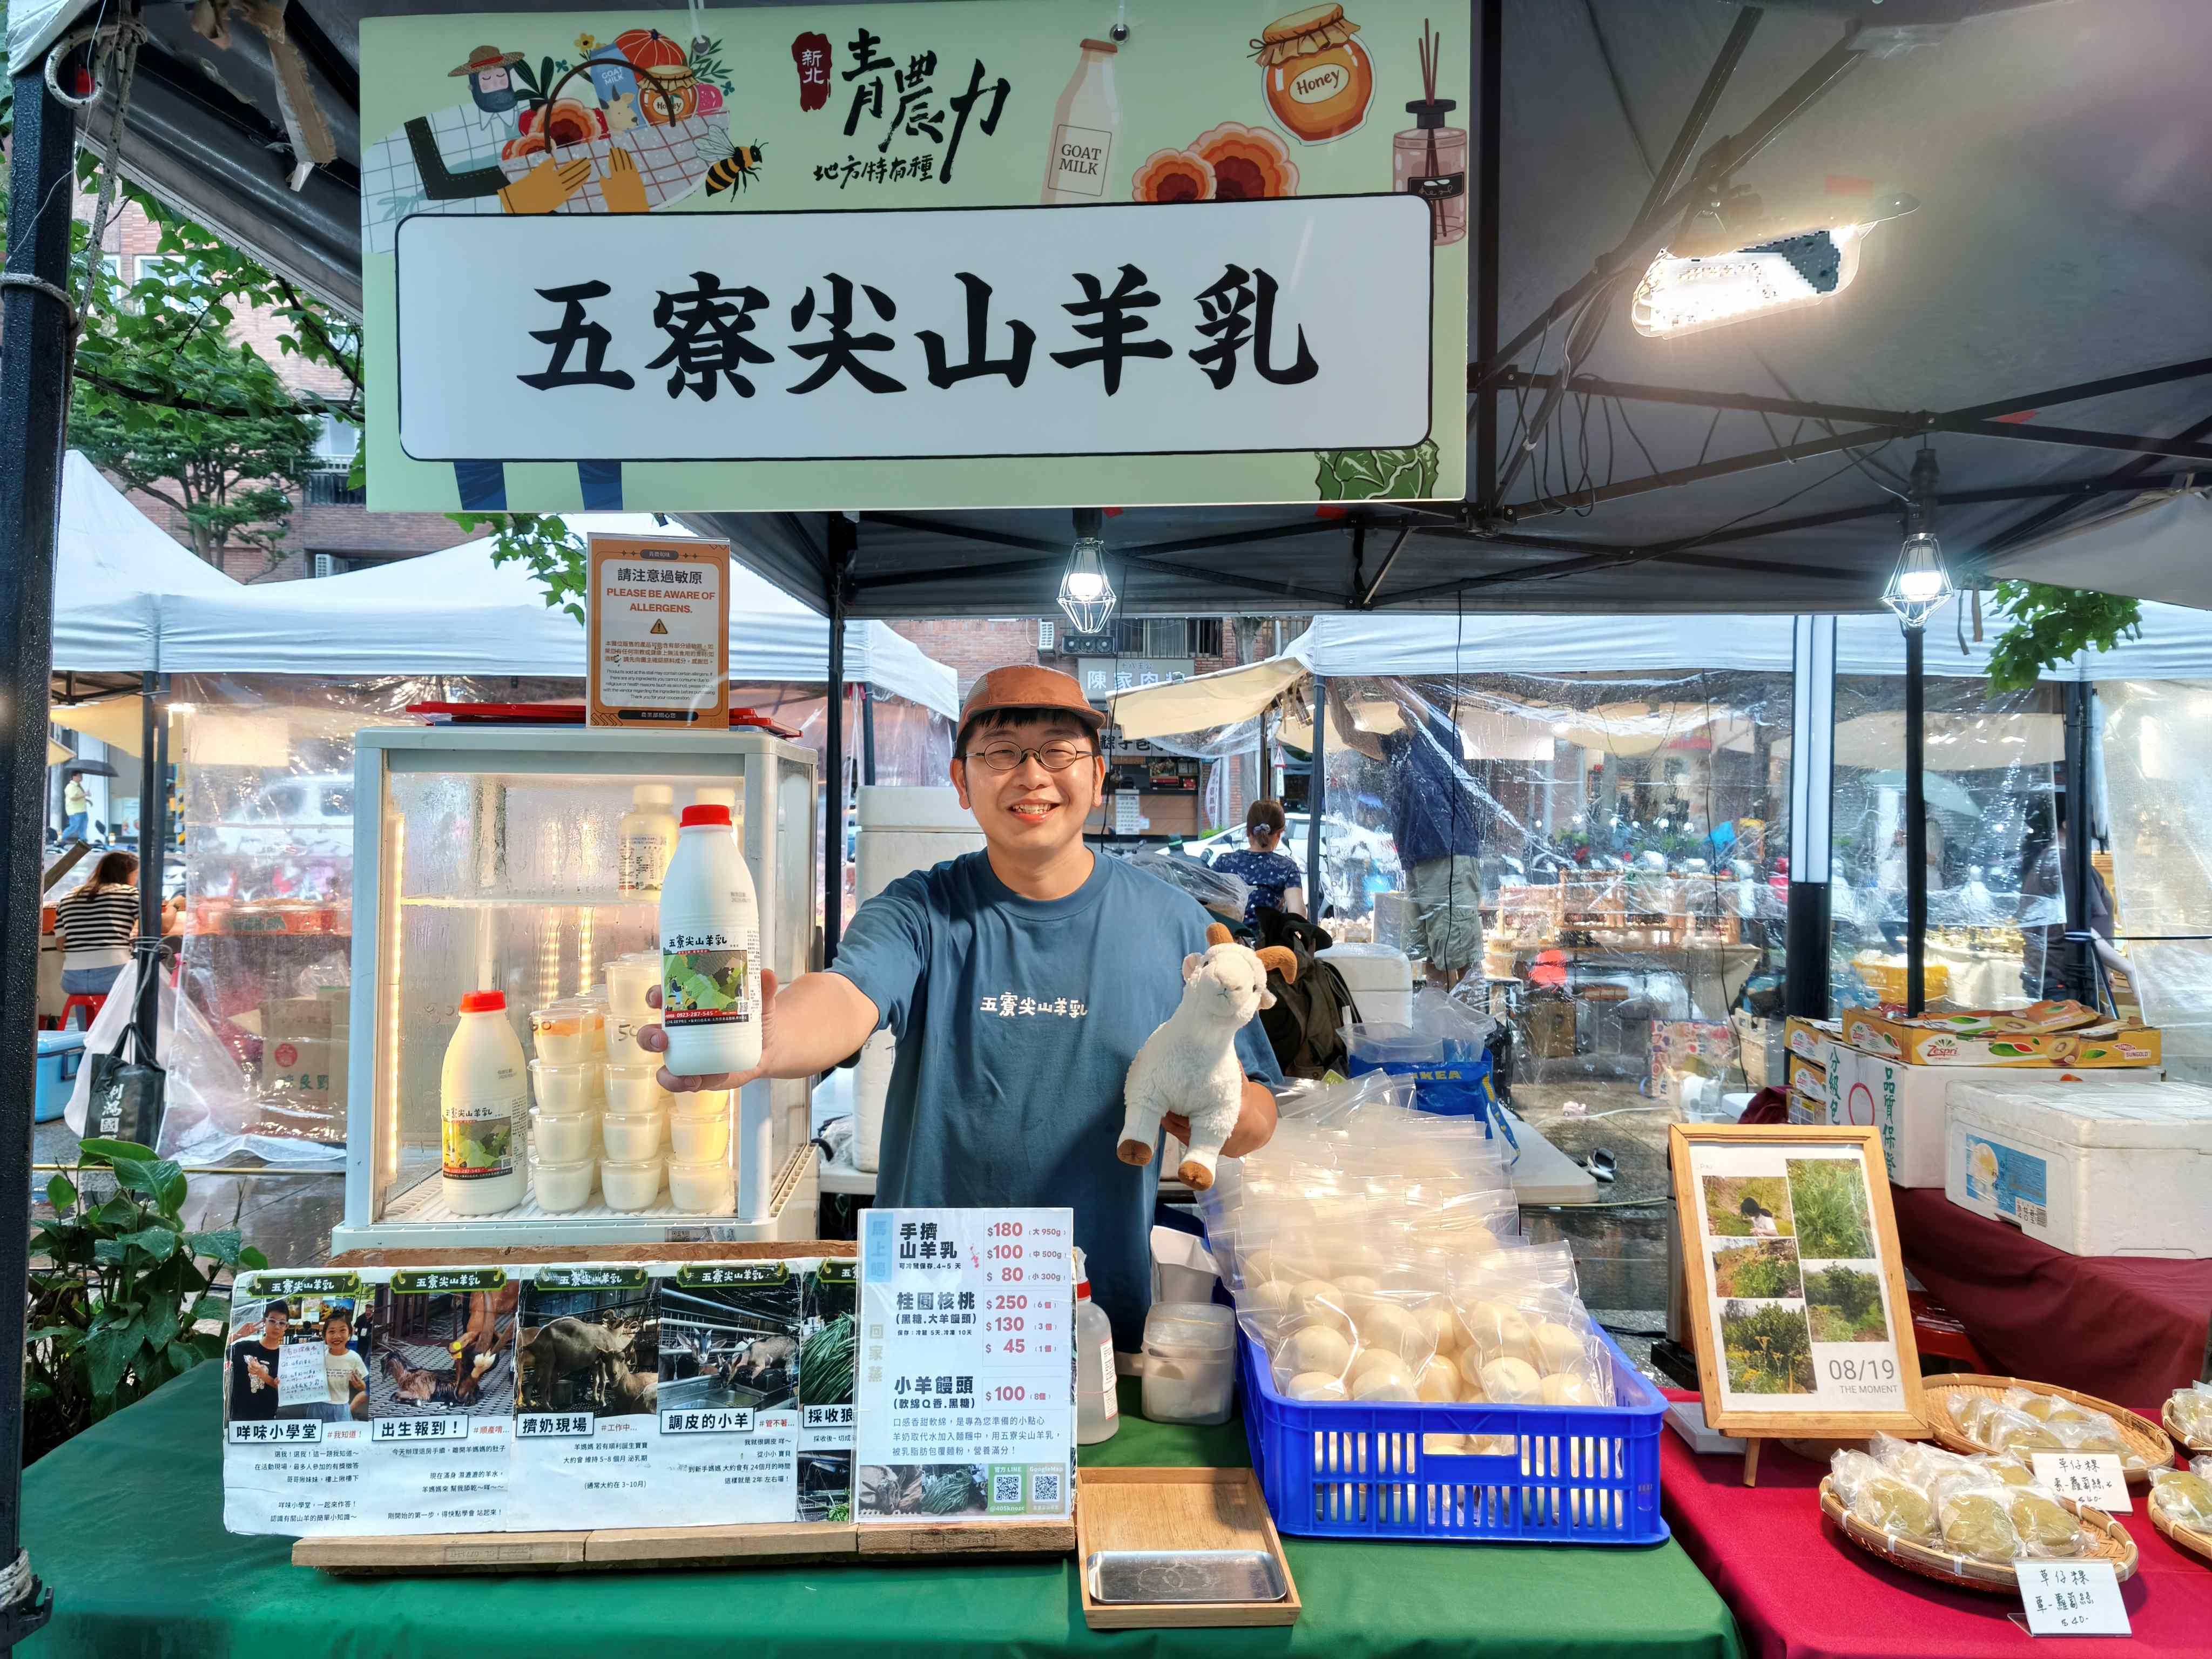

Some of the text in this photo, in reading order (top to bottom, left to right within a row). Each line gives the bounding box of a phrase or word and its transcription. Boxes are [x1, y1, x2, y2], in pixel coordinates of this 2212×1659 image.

[602, 66, 622, 79] GOAT
[802, 49, 825, 84] 新北
[604, 75, 624, 86] MILK
[1296, 69, 1341, 96] Honey
[657, 101, 682, 112] Hoey
[841, 28, 1011, 184] 青農力
[1061, 144, 1102, 162] GOAT
[813, 154, 934, 190] 地方特有種
[1059, 159, 1098, 176] MILK
[516, 263, 1319, 402] 五寮尖山羊乳
[618, 568, 703, 584] 請注意過敏原
[606, 588, 716, 601] PLEASE BE AWARE OF
[630, 603, 693, 613] ALLERGENS.
[669, 934, 727, 949] 五寮尖山羊乳
[980, 992, 1088, 1019] 五寮尖山羊乳
[1927, 1044, 1960, 1057] Zespri
[900, 1222, 938, 1241] 手擠
[987, 1222, 1023, 1237] $180
[900, 1241, 957, 1259] 山羊乳
[987, 1244, 1023, 1259] $100
[416, 1274, 481, 1290] 五寮尖山羊乳
[702, 1269, 764, 1284] 五寮尖山羊乳
[271, 1278, 334, 1294] 五寮尖山羊乳
[896, 1291, 975, 1311] 桂圓核桃
[1829, 1359, 1894, 1381] 08/19
[894, 1375, 974, 1395] 小羊饅頭
[1839, 1385, 1897, 1394] THE MOMENT
[381, 1420, 458, 1438] 出生報到！
[523, 1417, 587, 1434] 擠奶現場
[669, 1413, 748, 1430] 調皮的小羊
[596, 1442, 648, 1451] 若有順利誕生寶寶
[563, 1456, 583, 1464] 大約會
[689, 1465, 721, 1473] 到新手媽媽
[725, 1476, 751, 1485] 這樣就是
[2039, 1569, 2090, 1587] 草仔粿
